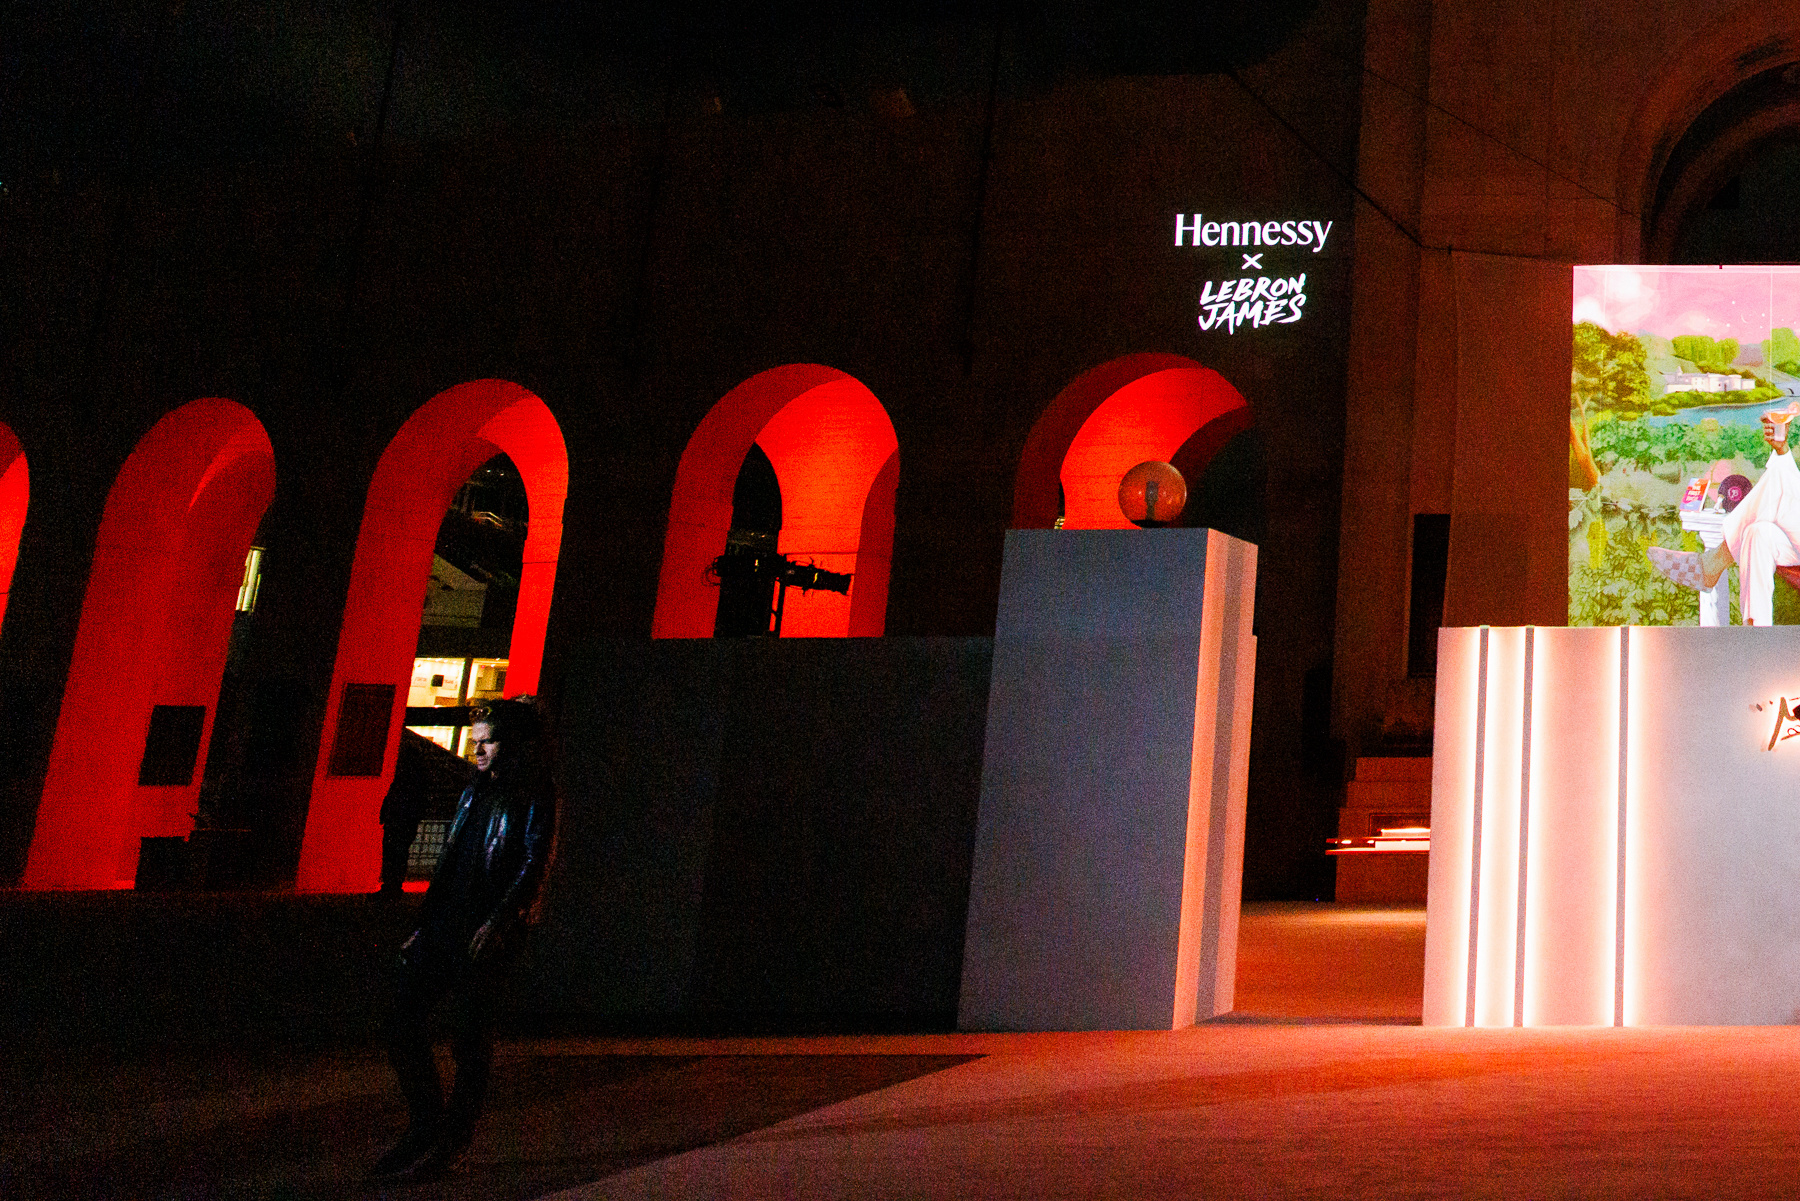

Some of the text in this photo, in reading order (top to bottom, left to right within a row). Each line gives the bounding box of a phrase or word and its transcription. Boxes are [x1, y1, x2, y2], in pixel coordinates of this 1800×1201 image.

[1174, 213, 1333, 253] Hennessy
[1200, 273, 1307, 306] LEBRON
[1198, 293, 1307, 335] JAMES
